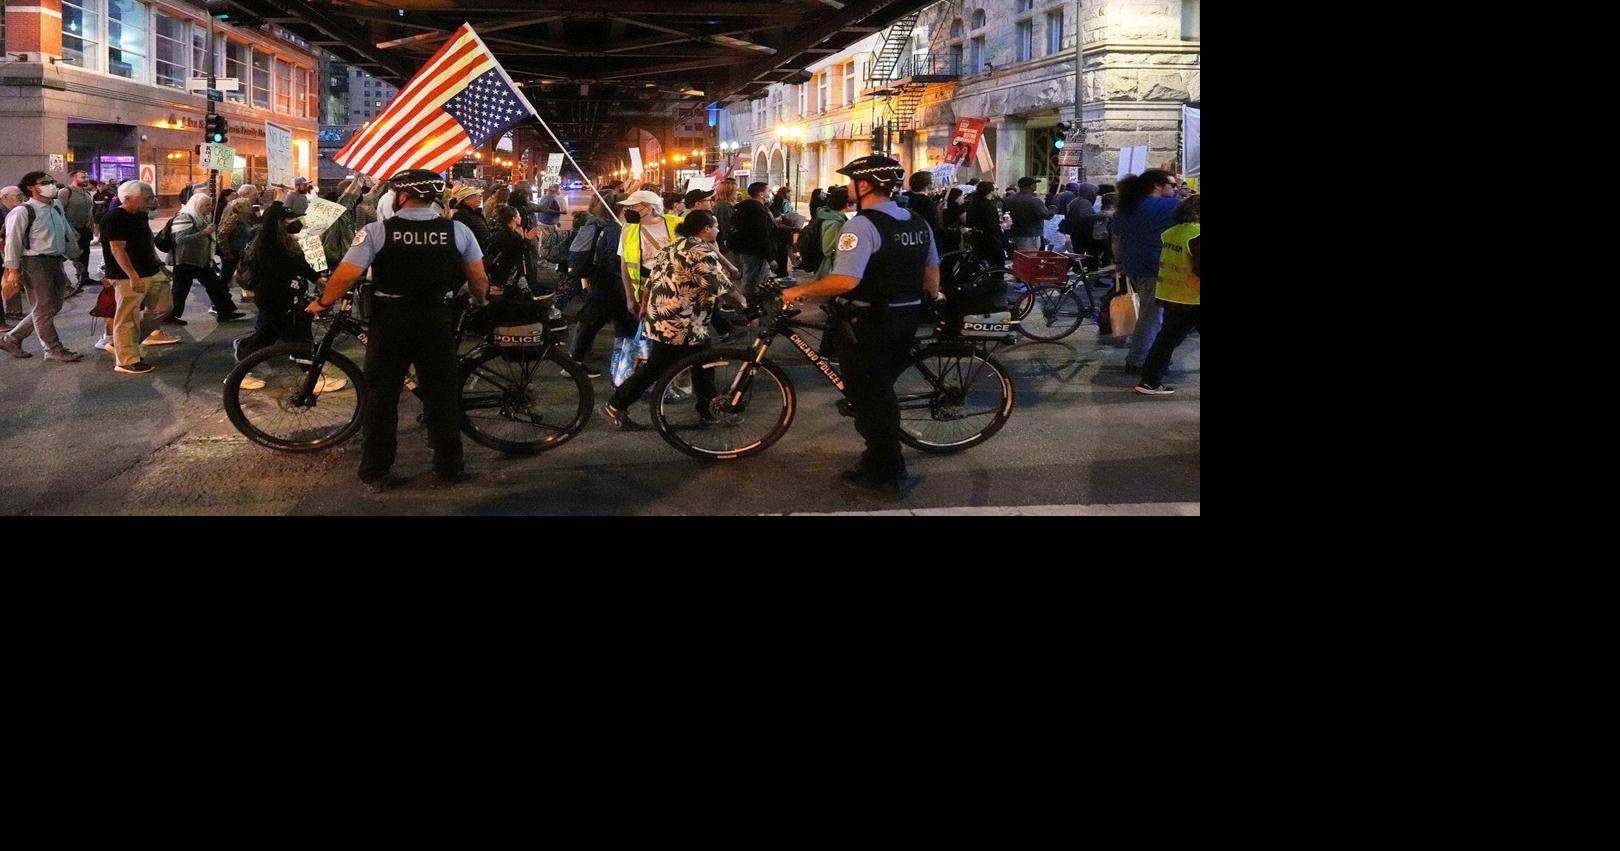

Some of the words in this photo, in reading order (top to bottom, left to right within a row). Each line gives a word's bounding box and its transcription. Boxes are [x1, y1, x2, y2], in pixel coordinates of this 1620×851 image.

[393, 231, 448, 245] POLICE
[894, 230, 928, 246] POLICE
[963, 321, 1010, 332] POLICE
[494, 335, 541, 344] POLICE
[790, 334, 819, 361] CHICAGO
[816, 359, 841, 384] POLICE
